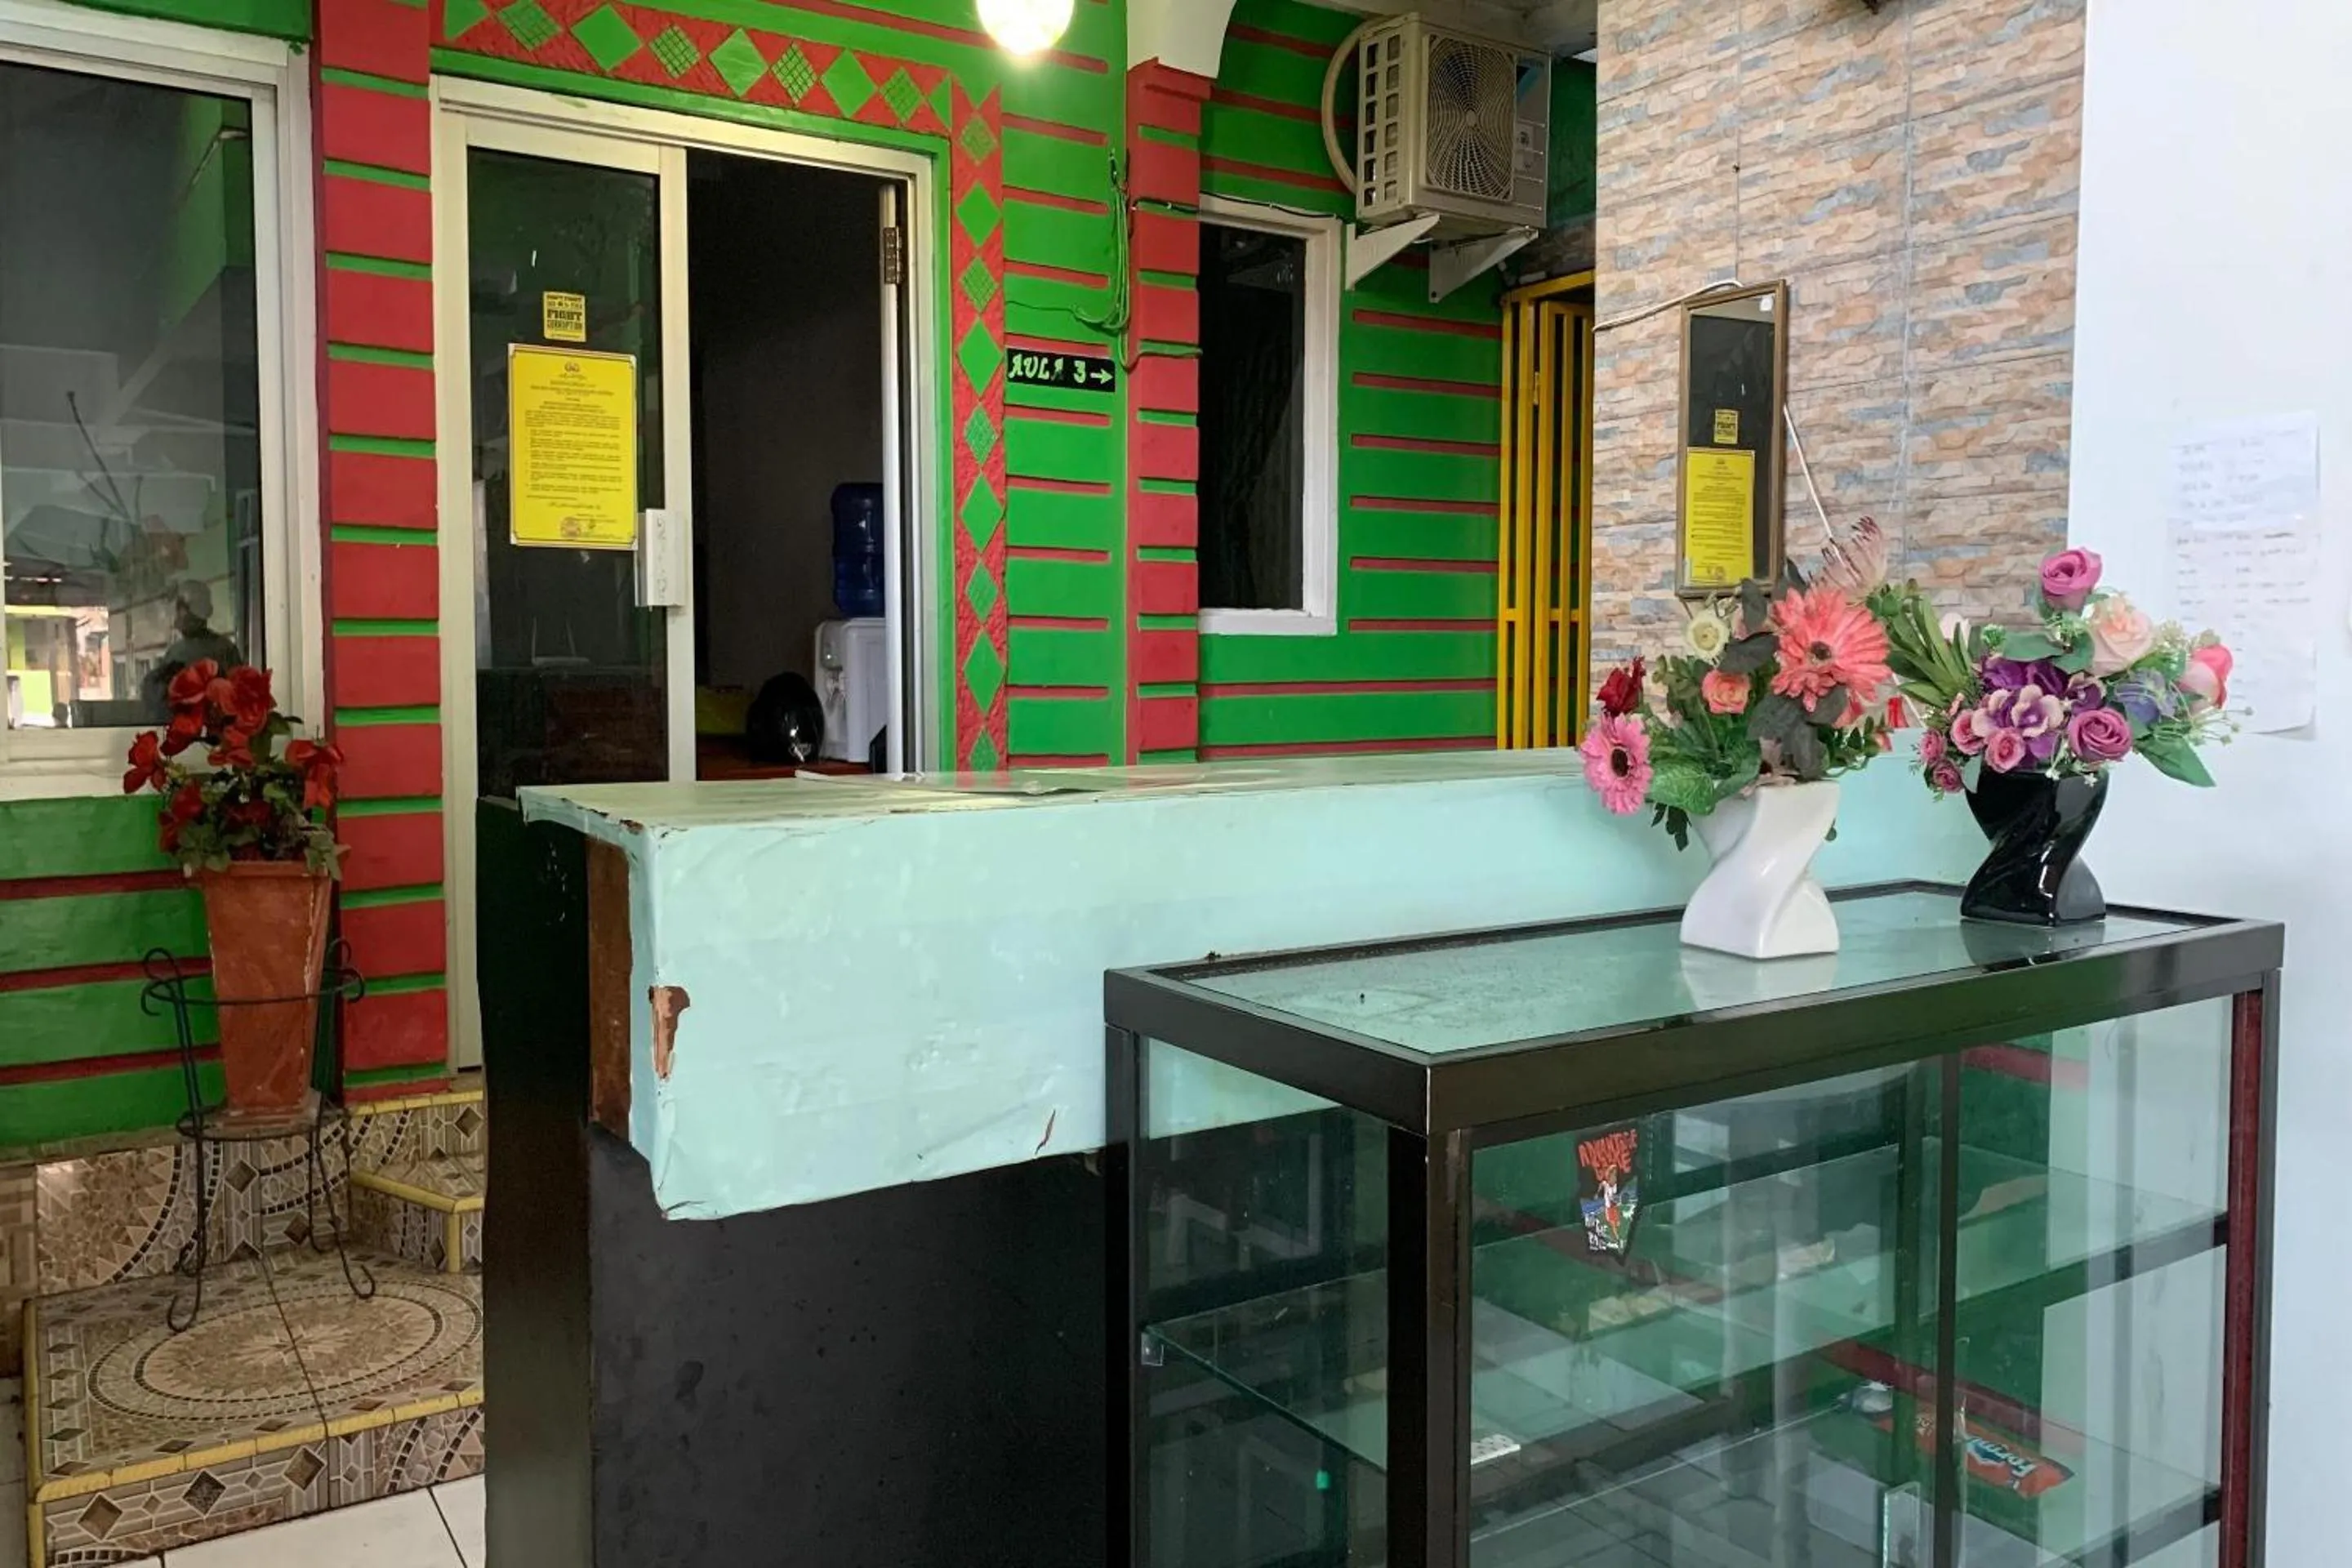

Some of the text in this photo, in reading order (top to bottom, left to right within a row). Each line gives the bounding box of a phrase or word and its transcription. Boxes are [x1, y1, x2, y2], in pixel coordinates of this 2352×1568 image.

[547, 310, 582, 321] FIGHT
[1008, 353, 1086, 384] AULA 3
